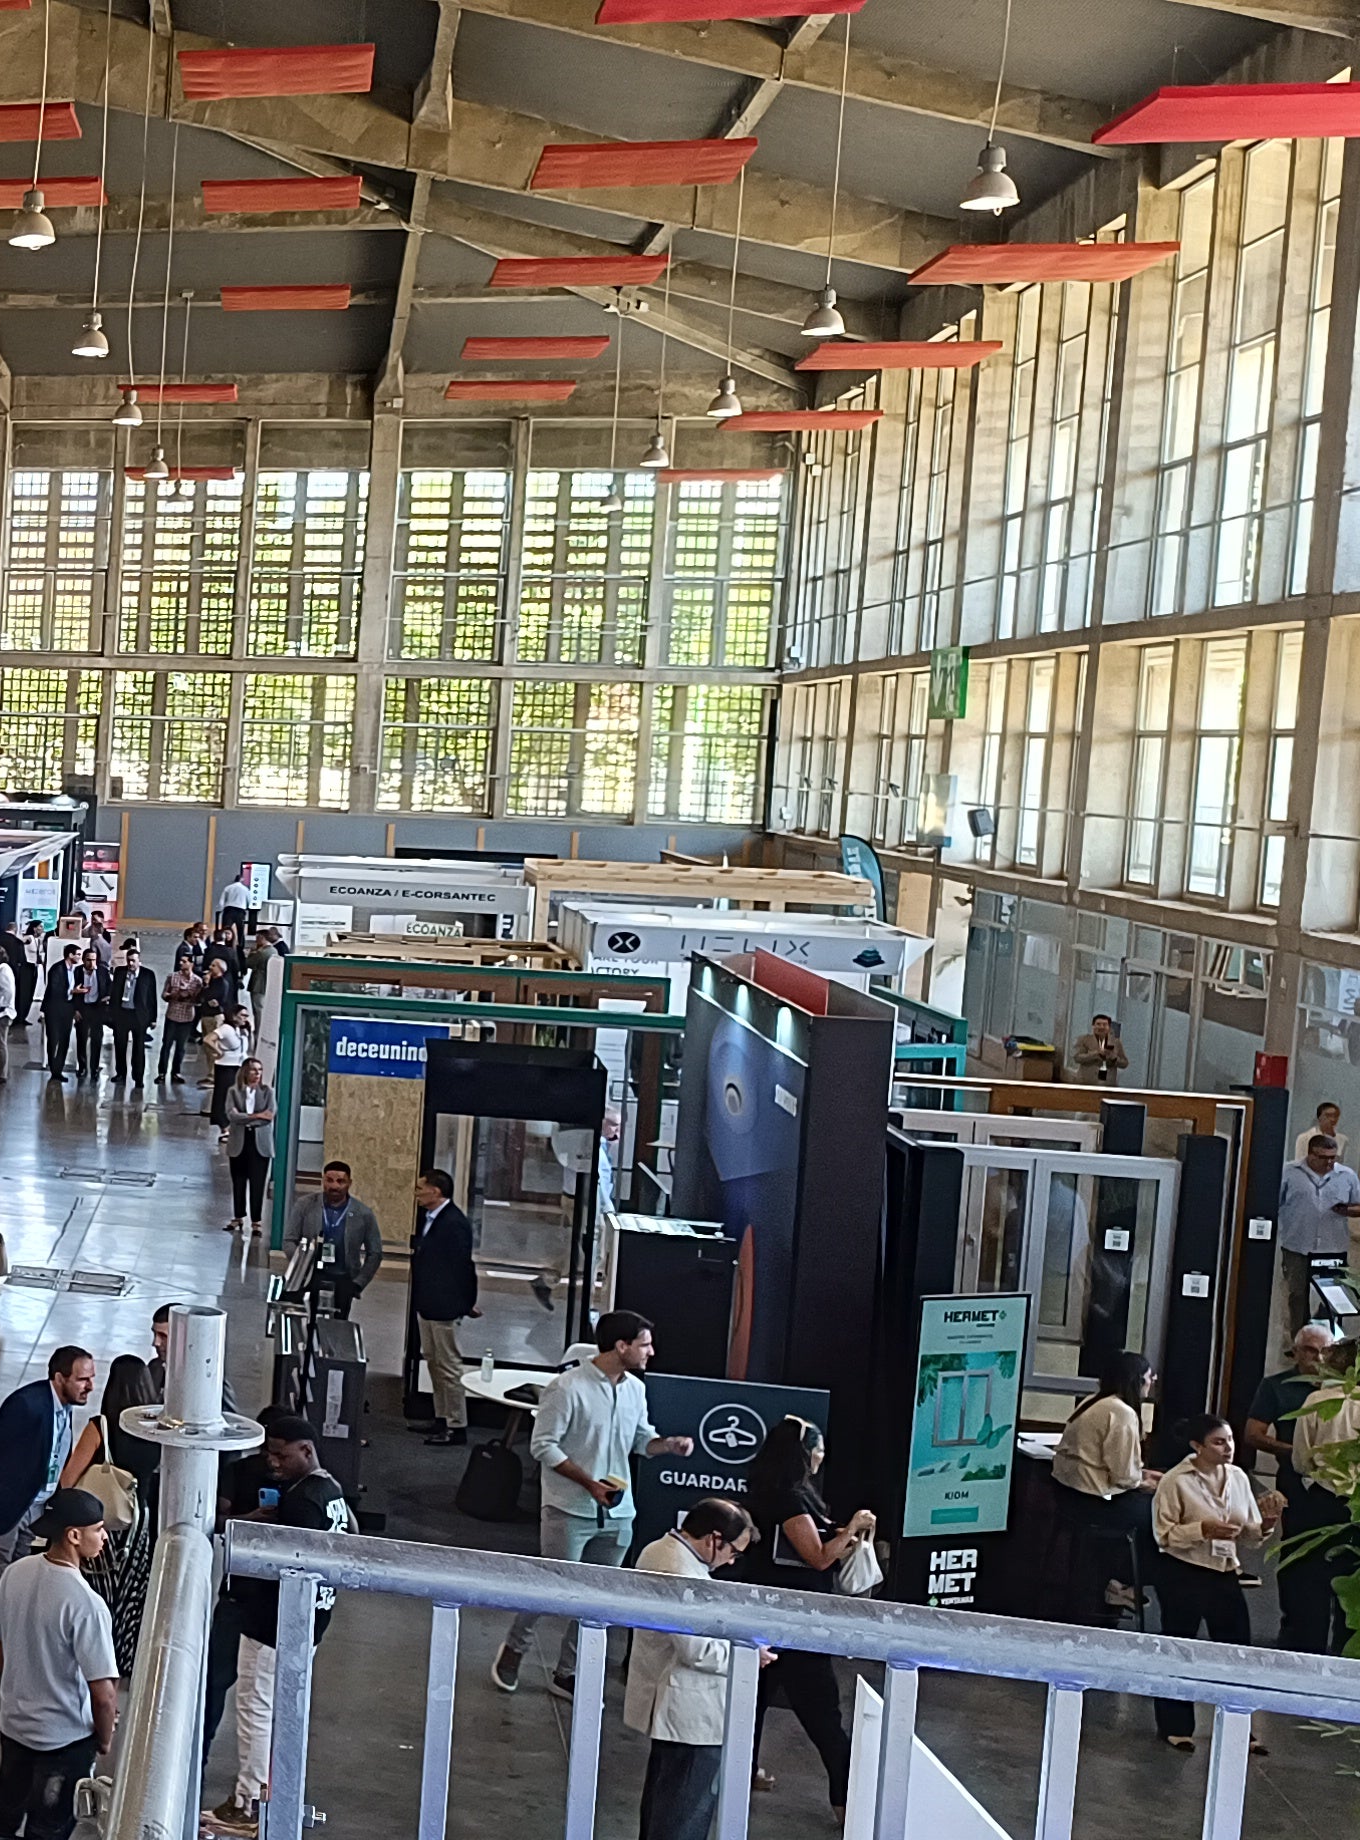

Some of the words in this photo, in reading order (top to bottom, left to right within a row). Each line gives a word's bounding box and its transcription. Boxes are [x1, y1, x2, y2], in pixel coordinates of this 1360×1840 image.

[330, 886, 391, 896] ECOANZA
[402, 890, 495, 901] E-CORSANTEC
[406, 922, 462, 938] ECOANZA
[944, 1310, 999, 1323] HERMET
[659, 1470, 748, 1493] GUARDAR
[930, 1548, 978, 1572] HER
[928, 1572, 976, 1594] MET
